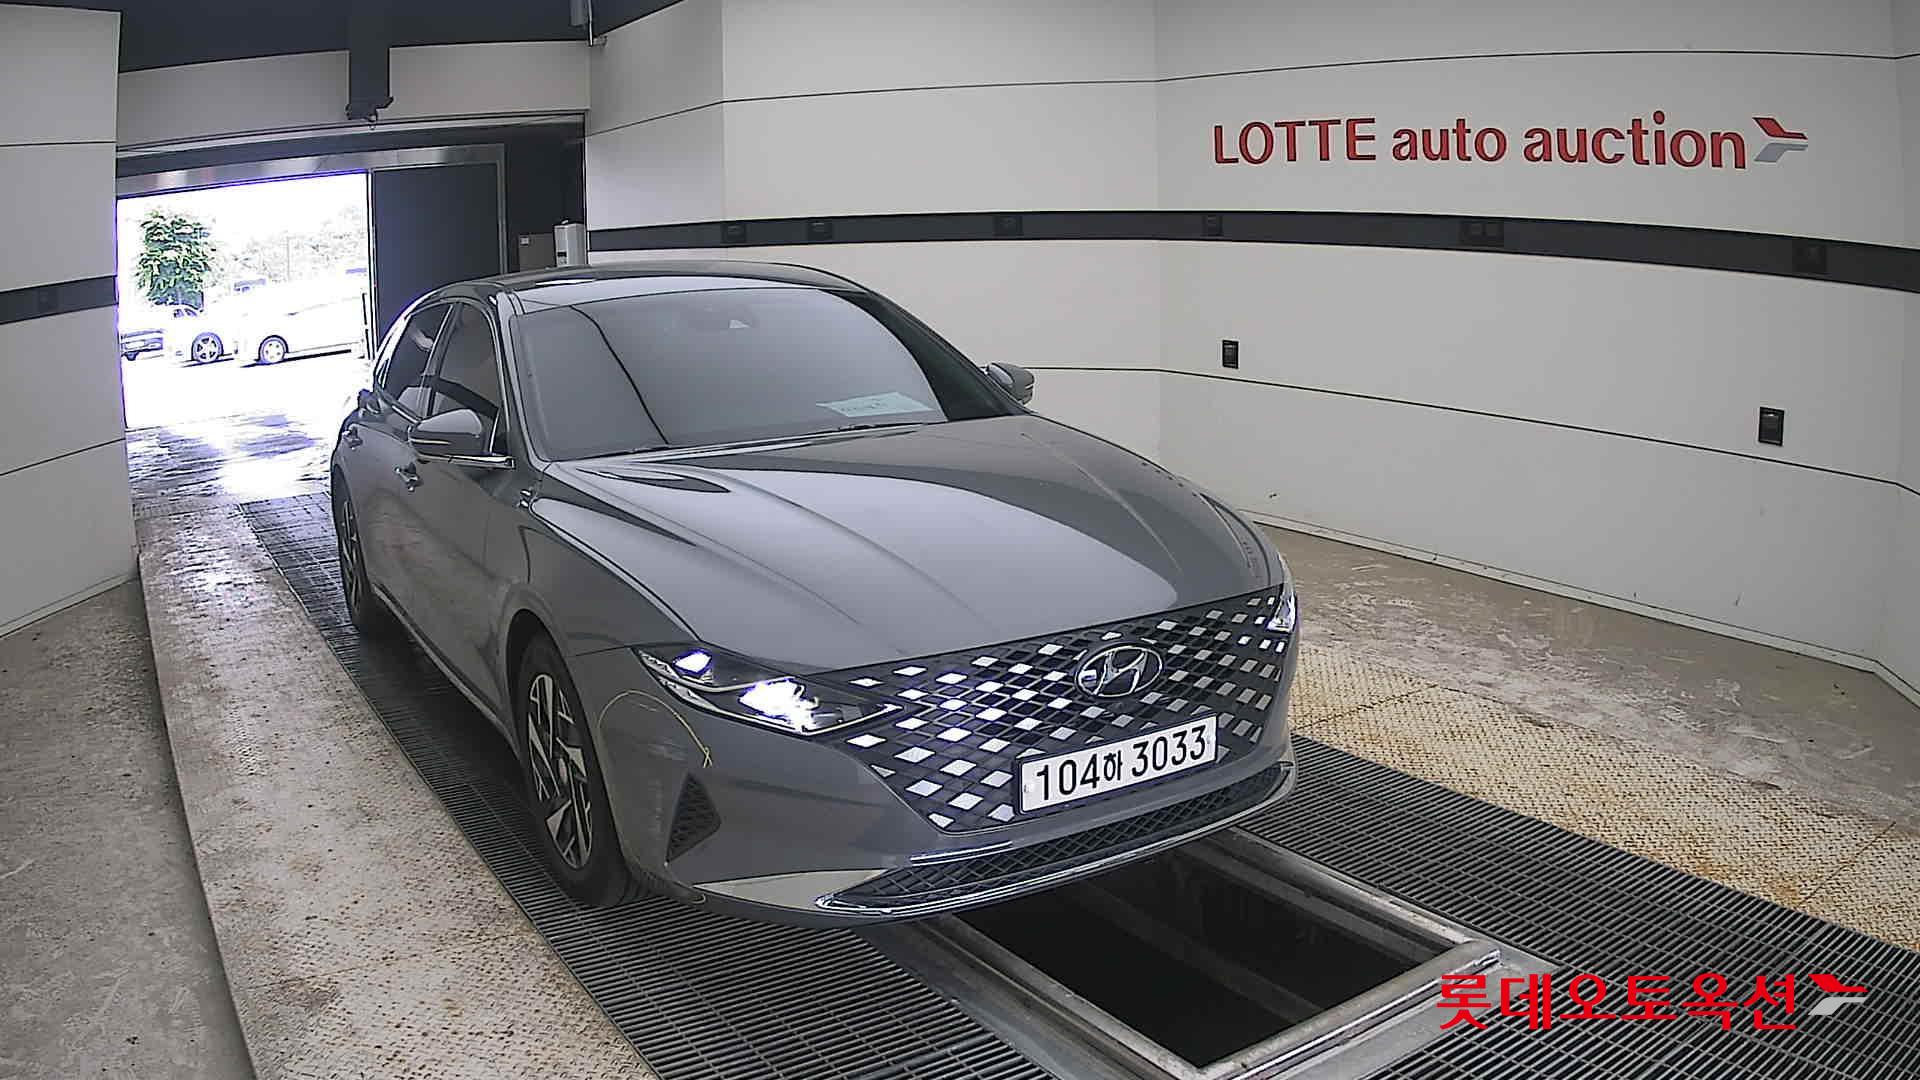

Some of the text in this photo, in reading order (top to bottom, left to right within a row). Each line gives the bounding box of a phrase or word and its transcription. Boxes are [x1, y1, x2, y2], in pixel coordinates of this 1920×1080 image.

[1213, 110, 1748, 169] LOTTE auto auction
[1036, 725, 1207, 800] 104하 3033
